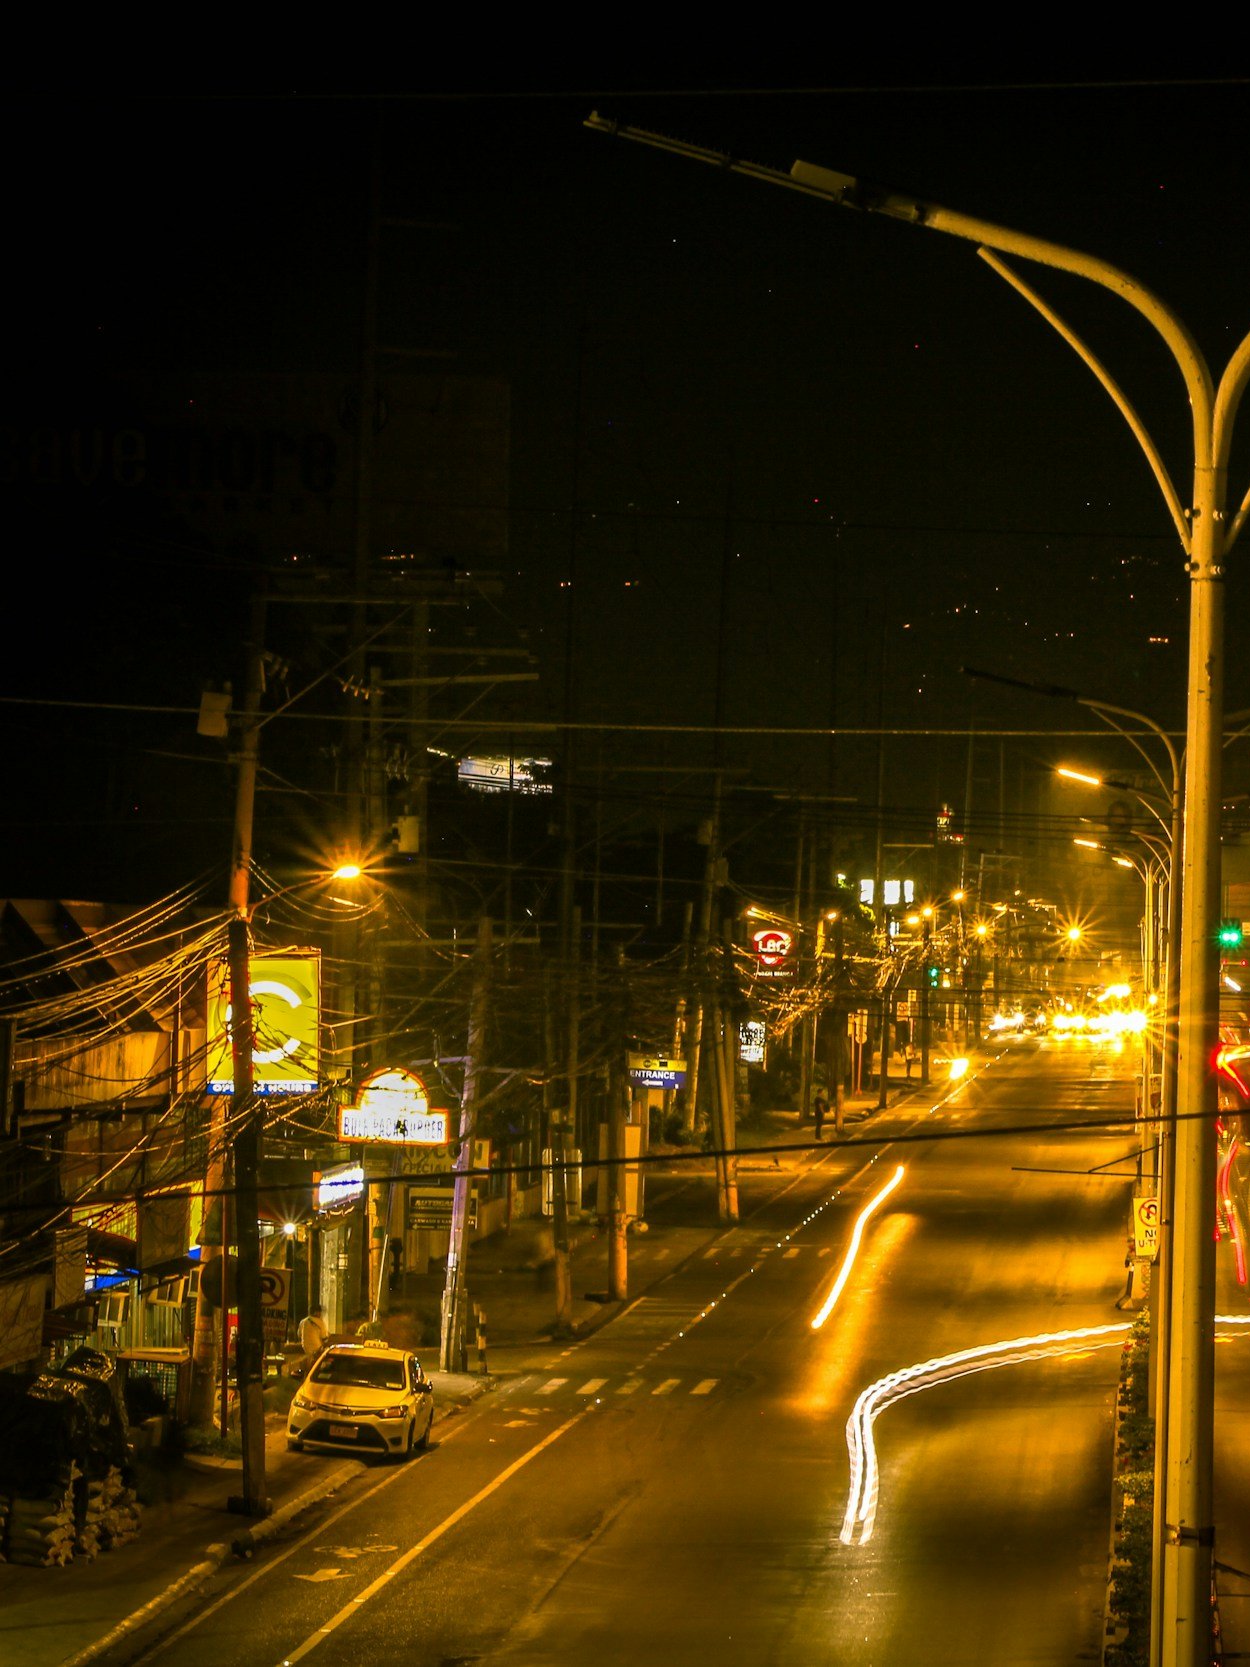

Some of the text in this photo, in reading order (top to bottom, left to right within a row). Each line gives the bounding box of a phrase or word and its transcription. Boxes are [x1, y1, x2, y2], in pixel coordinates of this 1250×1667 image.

[758, 938, 792, 956] LBC
[629, 1069, 676, 1080] ENTRANCE
[212, 1083, 235, 1093] OPE
